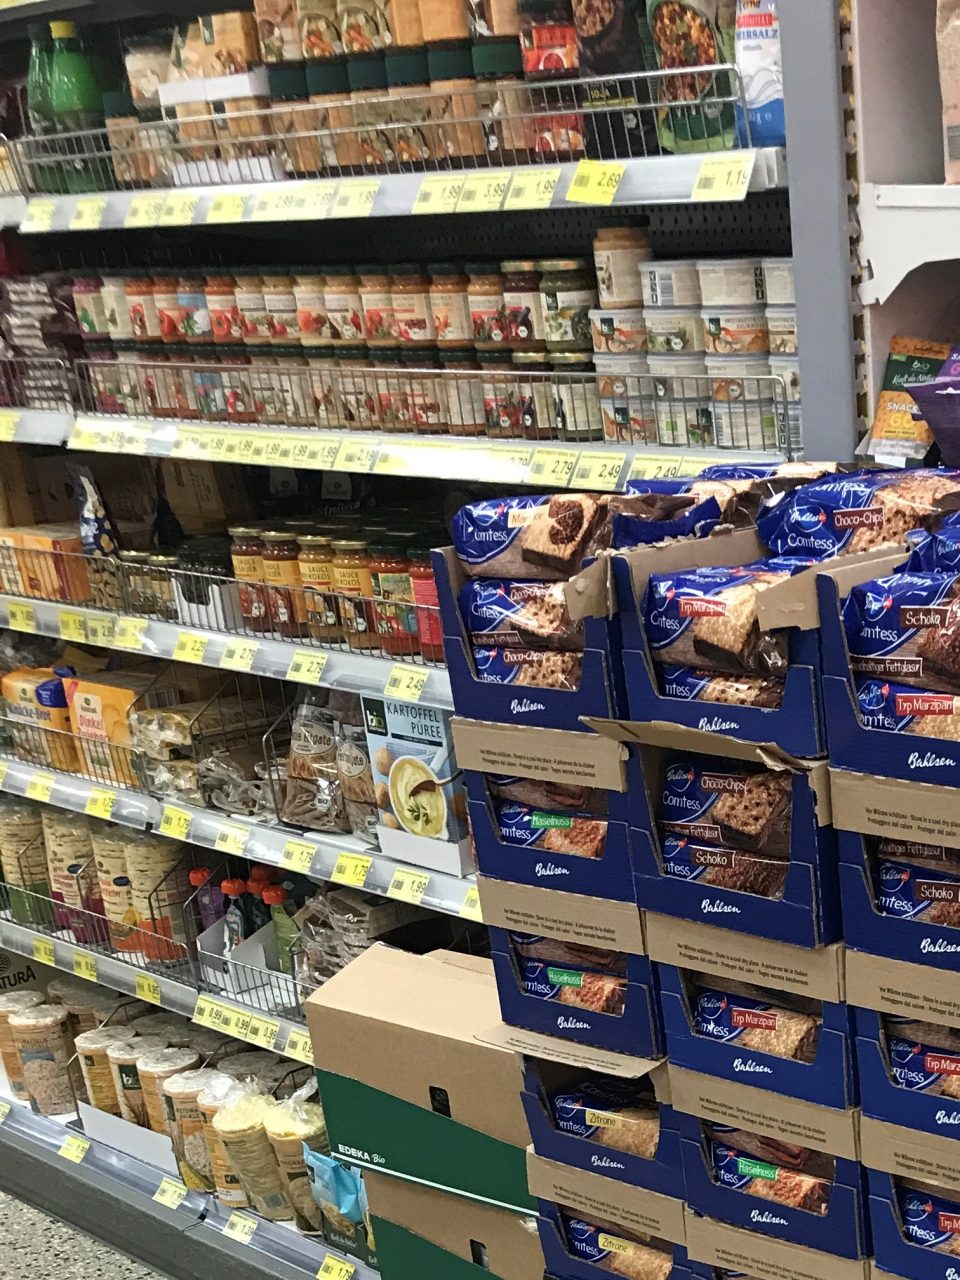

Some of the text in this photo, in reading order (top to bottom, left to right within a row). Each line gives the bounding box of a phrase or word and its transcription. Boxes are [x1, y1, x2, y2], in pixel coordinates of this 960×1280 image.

[597, 171, 620, 189] 2,69
[889, 413, 915, 427] GO
[552, 460, 573, 475] 2,79
[600, 463, 620, 479] 2,49
[834, 512, 883, 528] Choco-Chips
[787, 533, 834, 550] Comtess
[905, 611, 941, 626] Schoko
[307, 661, 323, 674] 2,79
[406, 675, 424, 691] 2,49
[386, 701, 440, 724] KARTOFFEL
[510, 700, 546, 714] Bahlsen
[898, 700, 953, 715] Typ Marzipan
[411, 720, 442, 739] PÜREE
[698, 717, 740, 732] Bahlsen
[908, 751, 956, 769] Bahlsen
[701, 777, 744, 791] Choco-Chips
[662, 792, 701, 811] Comtess
[532, 815, 570, 827] Haselnuss
[695, 851, 728, 865] Schoko
[353, 864, 369, 878] 1,79
[535, 862, 570, 877] Bahlsen
[410, 878, 426, 893] 1,99
[920, 884, 954, 900] Schoko
[701, 899, 741, 914] Bahlsen
[549, 971, 581, 986] Haselnuss
[557, 1015, 591, 1029] Bahlsen
[733, 1013, 776, 1028] Typ Marzipan
[733, 1058, 773, 1074] Bahlsen
[926, 1056, 940, 1071] Typ
[590, 1112, 617, 1126] Zitrone
[338, 1143, 386, 1164] EDEKA Bio
[591, 1154, 625, 1169] Bahlsen
[738, 1161, 776, 1179] Haselnuss
[750, 1209, 789, 1225] Bahlsen
[940, 1215, 953, 1231] Typ
[602, 1236, 629, 1252] Zitrone
